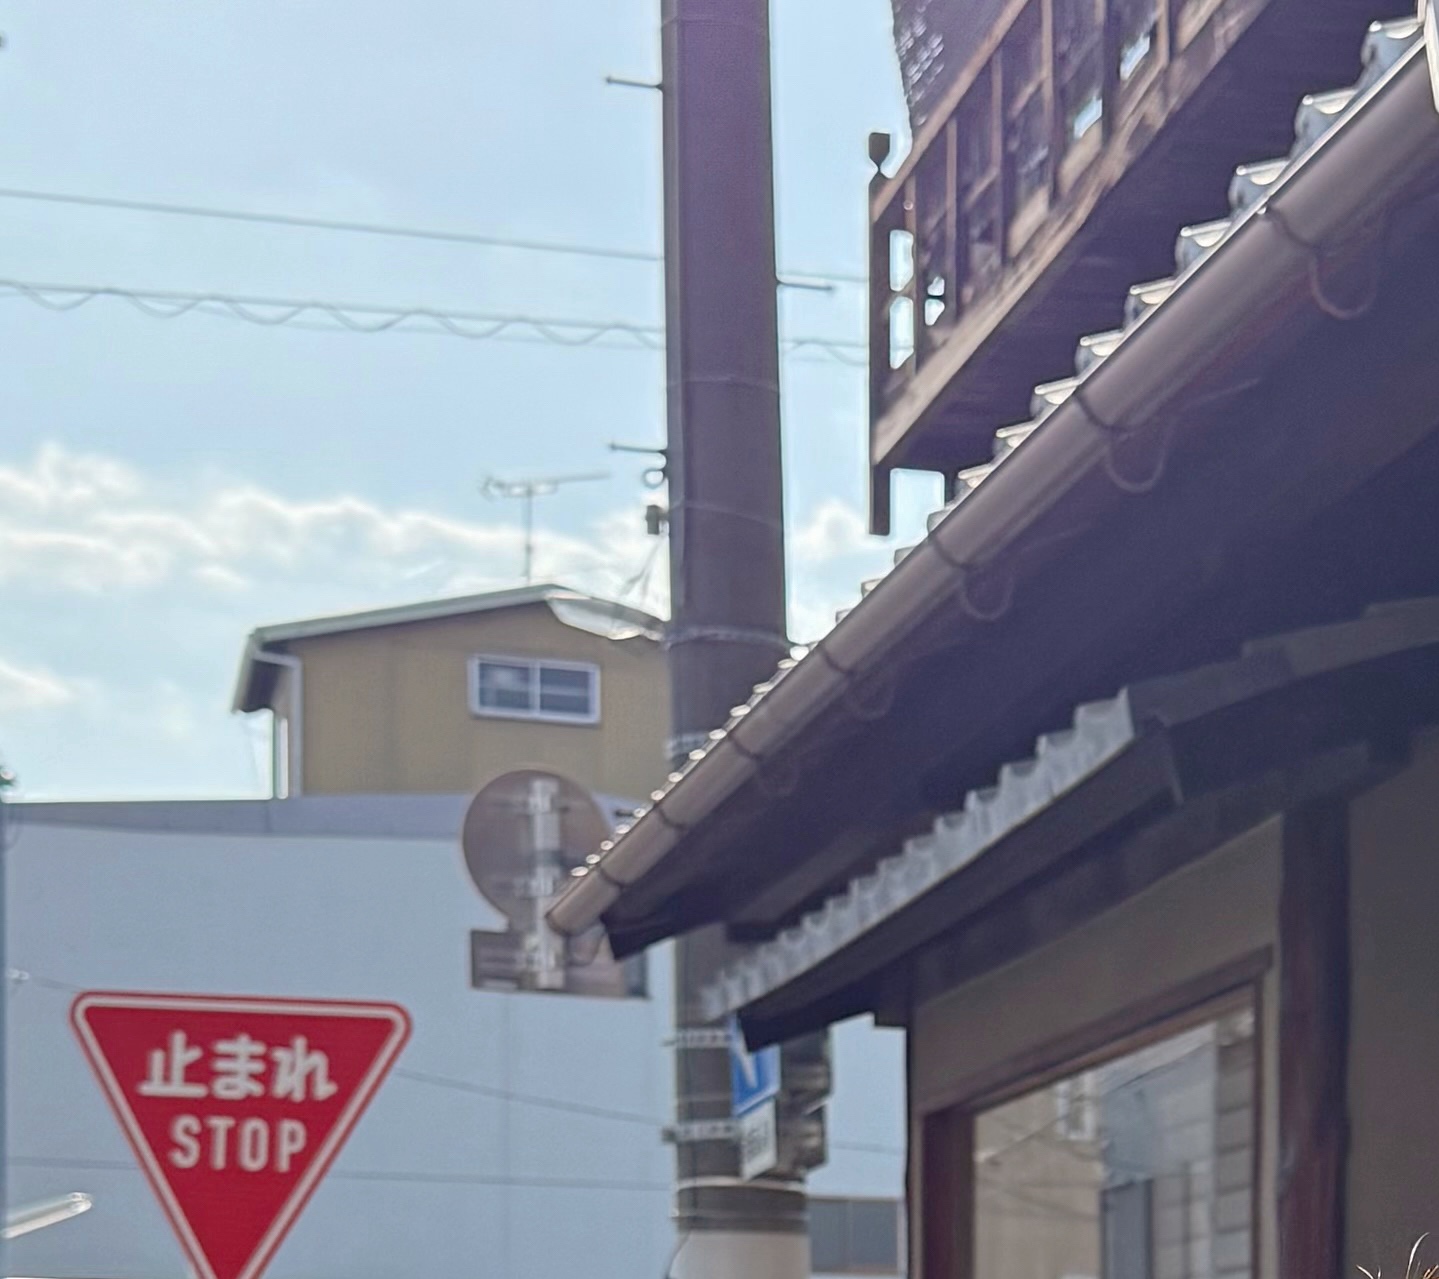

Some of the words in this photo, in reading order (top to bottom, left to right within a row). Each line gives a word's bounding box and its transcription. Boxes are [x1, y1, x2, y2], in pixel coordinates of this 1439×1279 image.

[138, 1029, 338, 1101] 止まれ
[169, 1115, 307, 1173] STOP
